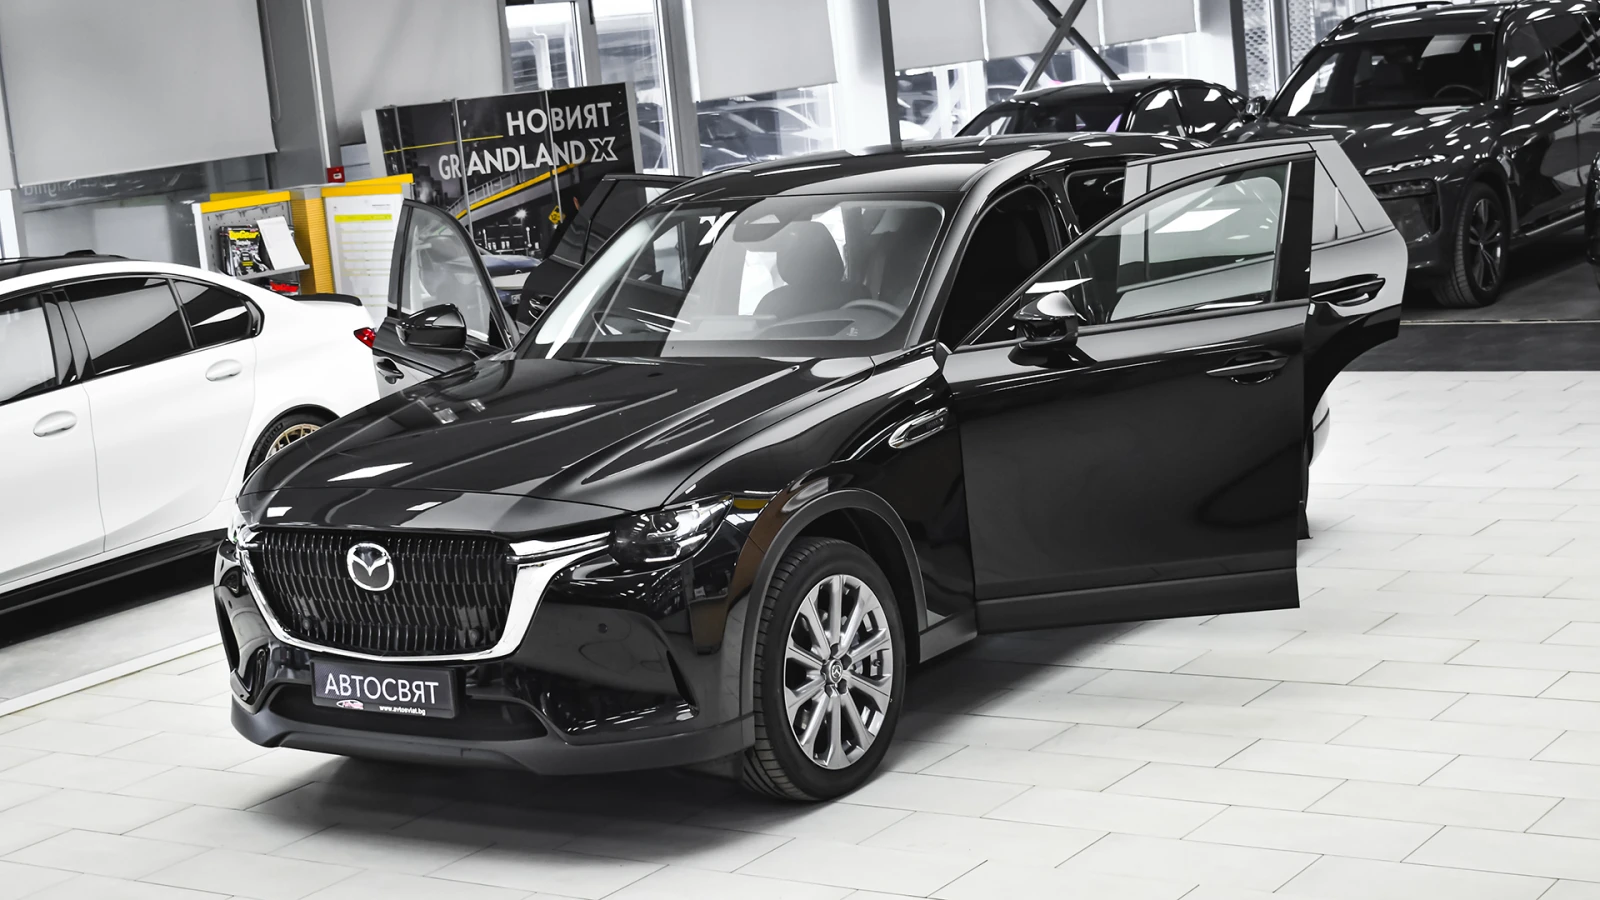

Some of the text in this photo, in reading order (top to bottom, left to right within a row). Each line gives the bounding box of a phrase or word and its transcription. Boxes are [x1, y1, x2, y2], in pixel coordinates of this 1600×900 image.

[506, 102, 612, 136] НОВИЯТ
[438, 136, 618, 180] GRANDLAND X
[324, 672, 439, 704] АВТОСВЯТ
